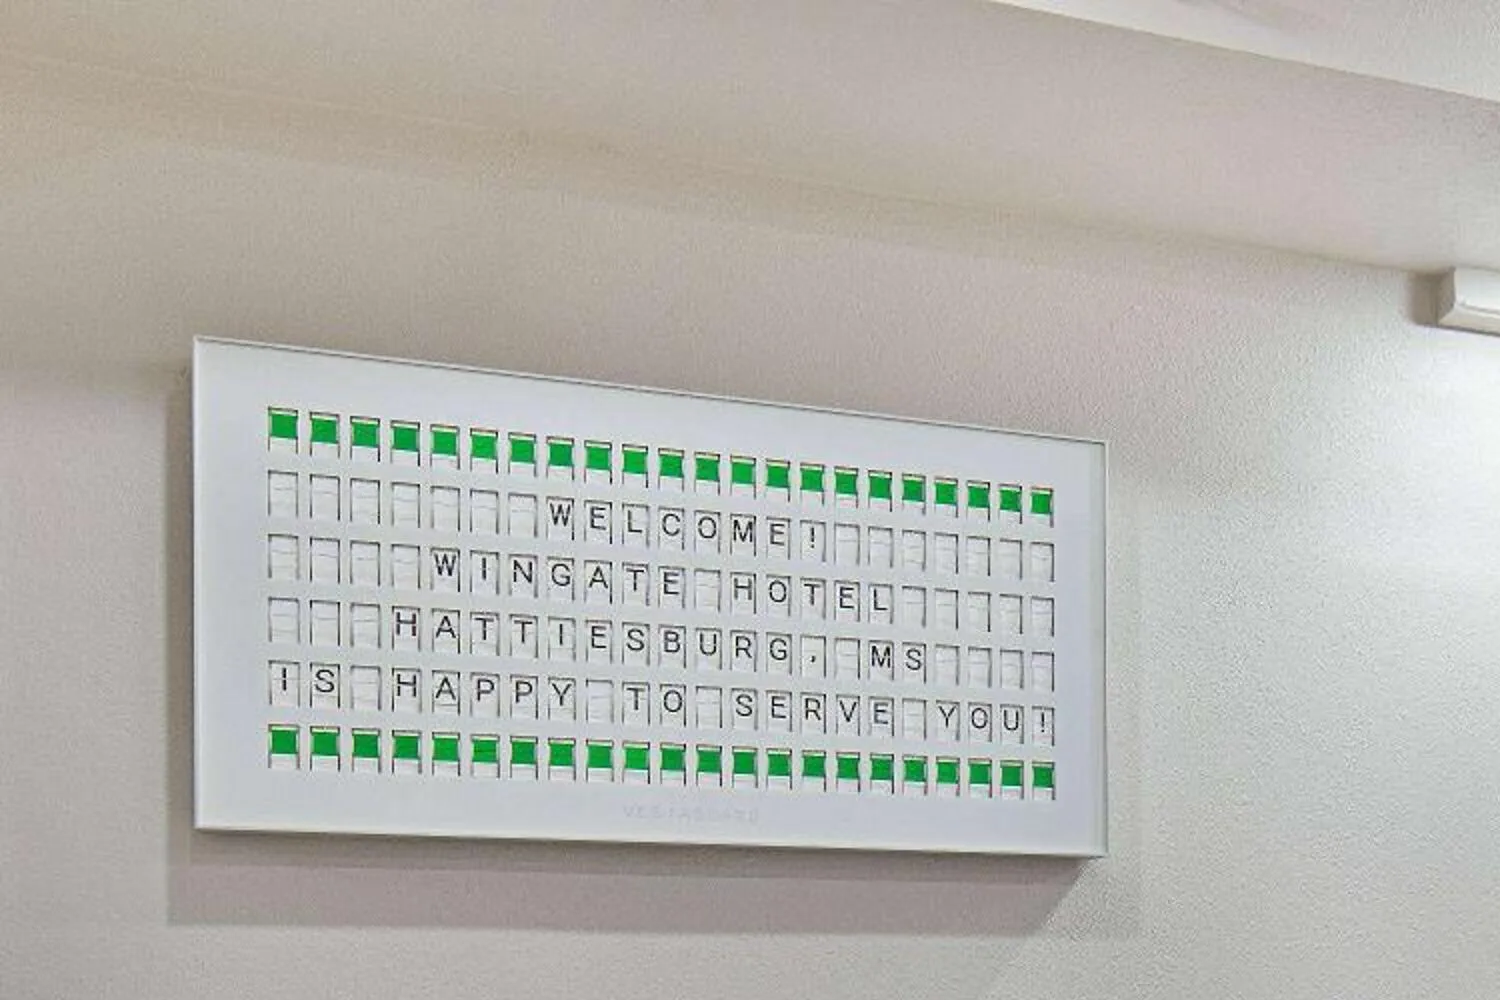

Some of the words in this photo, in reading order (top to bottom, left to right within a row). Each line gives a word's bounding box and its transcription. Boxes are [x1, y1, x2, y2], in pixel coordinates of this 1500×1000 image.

[549, 503, 816, 549] WELCOME!
[435, 553, 680, 596] WINGATE
[734, 577, 889, 611] HOTEL
[396, 612, 818, 663] HATTIESBURG,
[871, 645, 923, 670] MS
[281, 668, 336, 694] IS
[397, 676, 572, 706] HAPPY
[628, 688, 684, 713] TO
[736, 695, 889, 724] SERVE
[938, 705, 1046, 732] YOU!
